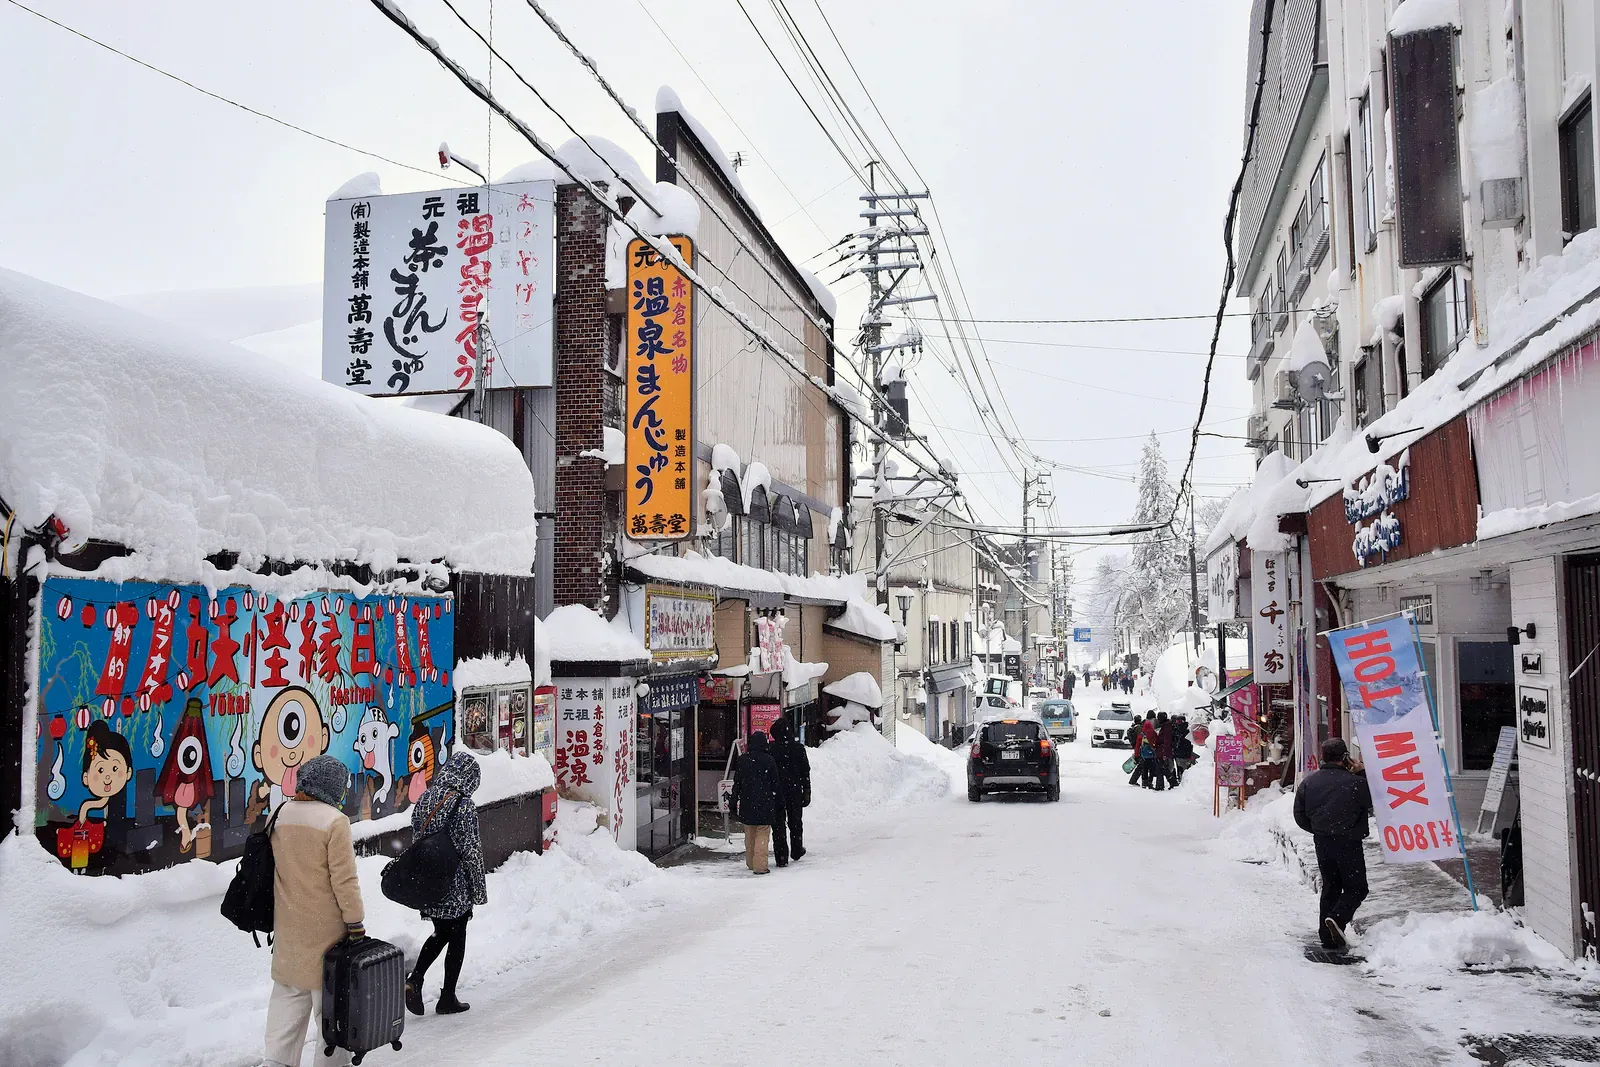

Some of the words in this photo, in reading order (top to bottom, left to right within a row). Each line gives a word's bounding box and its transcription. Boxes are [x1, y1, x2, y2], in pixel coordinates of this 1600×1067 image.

[422, 192, 481, 220] 元祖
[671, 275, 688, 374] 赤倉名物
[632, 276, 675, 506] 温泉まんじゅう
[674, 428, 686, 490] 製造本舗
[108, 622, 131, 680] 射的
[144, 603, 172, 696] カラオケ
[186, 605, 377, 692] 妖怪縁日
[207, 691, 251, 717] Yōkai
[330, 682, 376, 706] Festival
[562, 708, 590, 721] 元祖
[566, 729, 593, 788] 温泉
[592, 704, 604, 766] 赤倉名物
